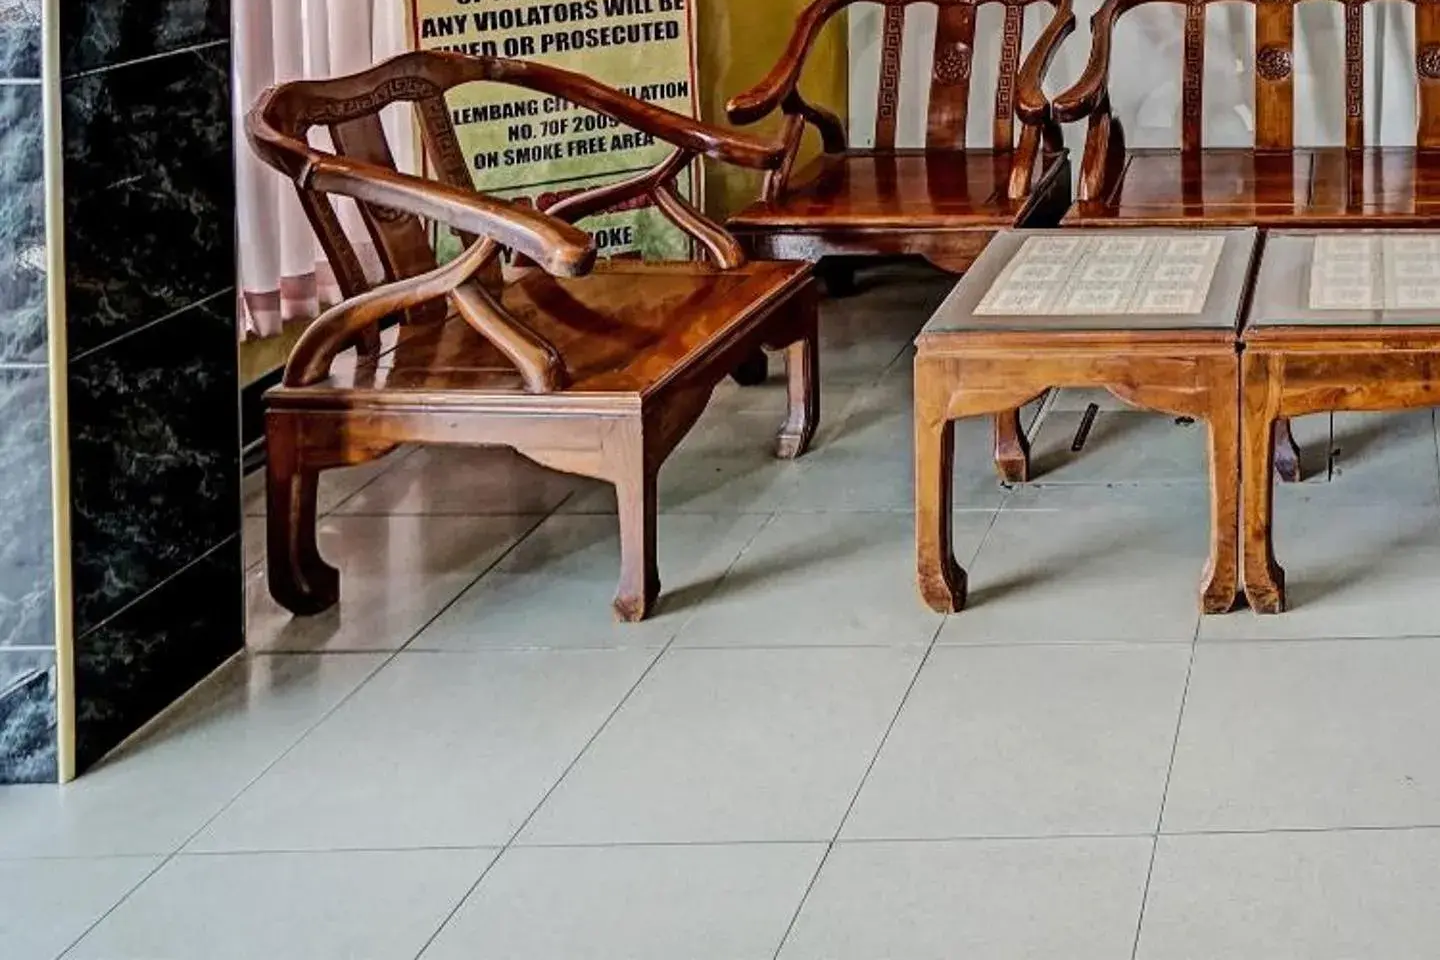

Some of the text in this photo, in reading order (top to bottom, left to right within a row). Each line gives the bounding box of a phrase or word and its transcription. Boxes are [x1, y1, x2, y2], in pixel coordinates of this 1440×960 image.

[422, 14, 467, 38] ANY
[431, 20, 679, 57] NED OR PROSECUTED
[453, 99, 538, 125] LEMBANG
[543, 96, 580, 113] CIT
[508, 124, 536, 141] NO.
[474, 131, 656, 169] ON SMOKE FREE AREA
